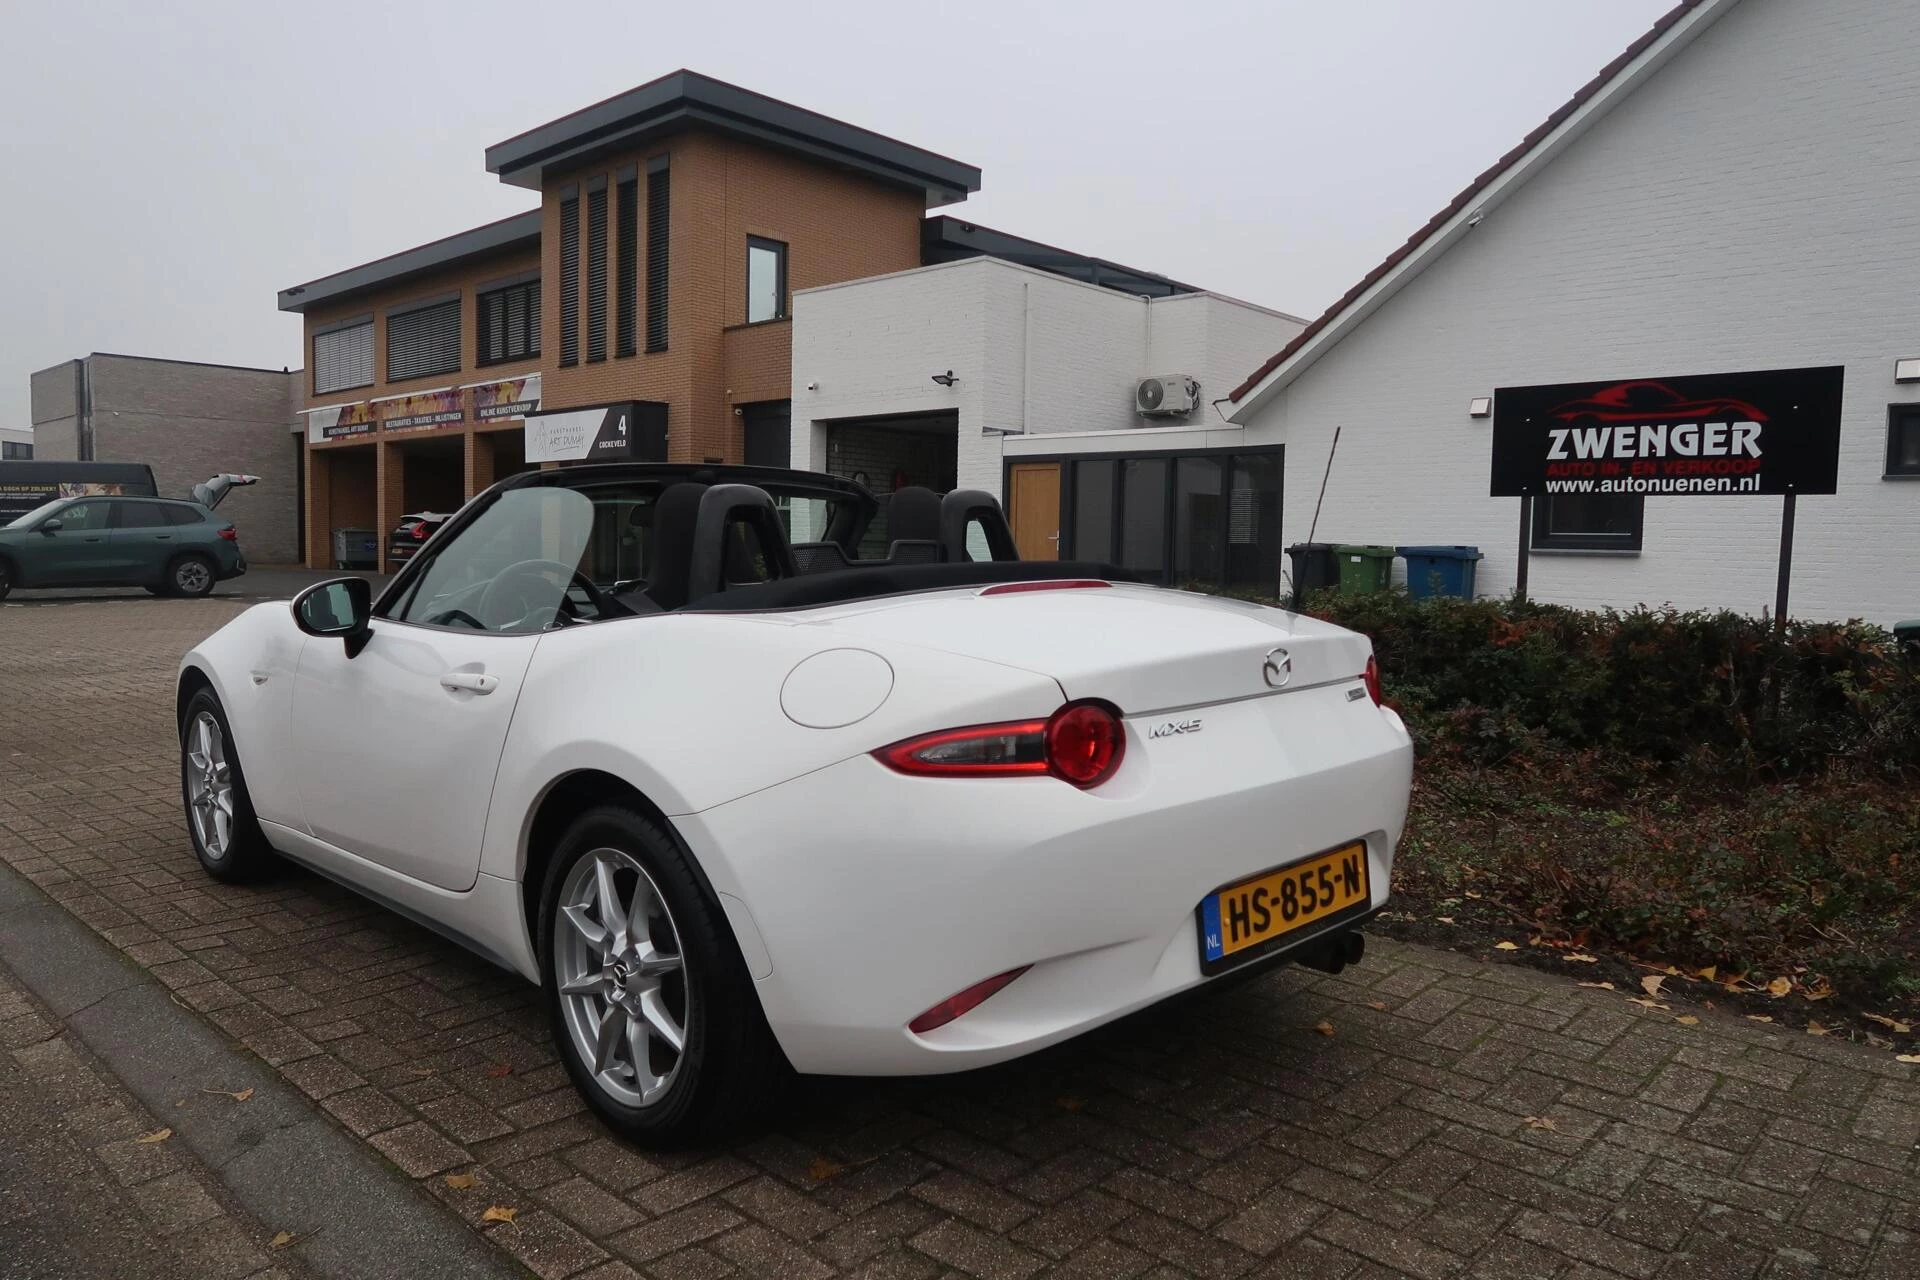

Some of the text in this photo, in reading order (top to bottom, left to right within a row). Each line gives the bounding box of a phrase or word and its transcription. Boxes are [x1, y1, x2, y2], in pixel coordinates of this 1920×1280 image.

[481, 403, 532, 417] ONLINE KUNSTVERKOOP
[618, 415, 627, 435] 4
[549, 436, 561, 448] ART
[599, 439, 627, 449] COCKEVELD
[1546, 421, 1762, 460] ZWENGER
[1545, 459, 1761, 477] AUTO IN- EN VERKOOP
[1545, 473, 1761, 494] www.autonuenen.nl
[1149, 719, 1202, 740] MX-5
[1229, 854, 1360, 943] HS-855-N
[1207, 934, 1220, 949] NL
